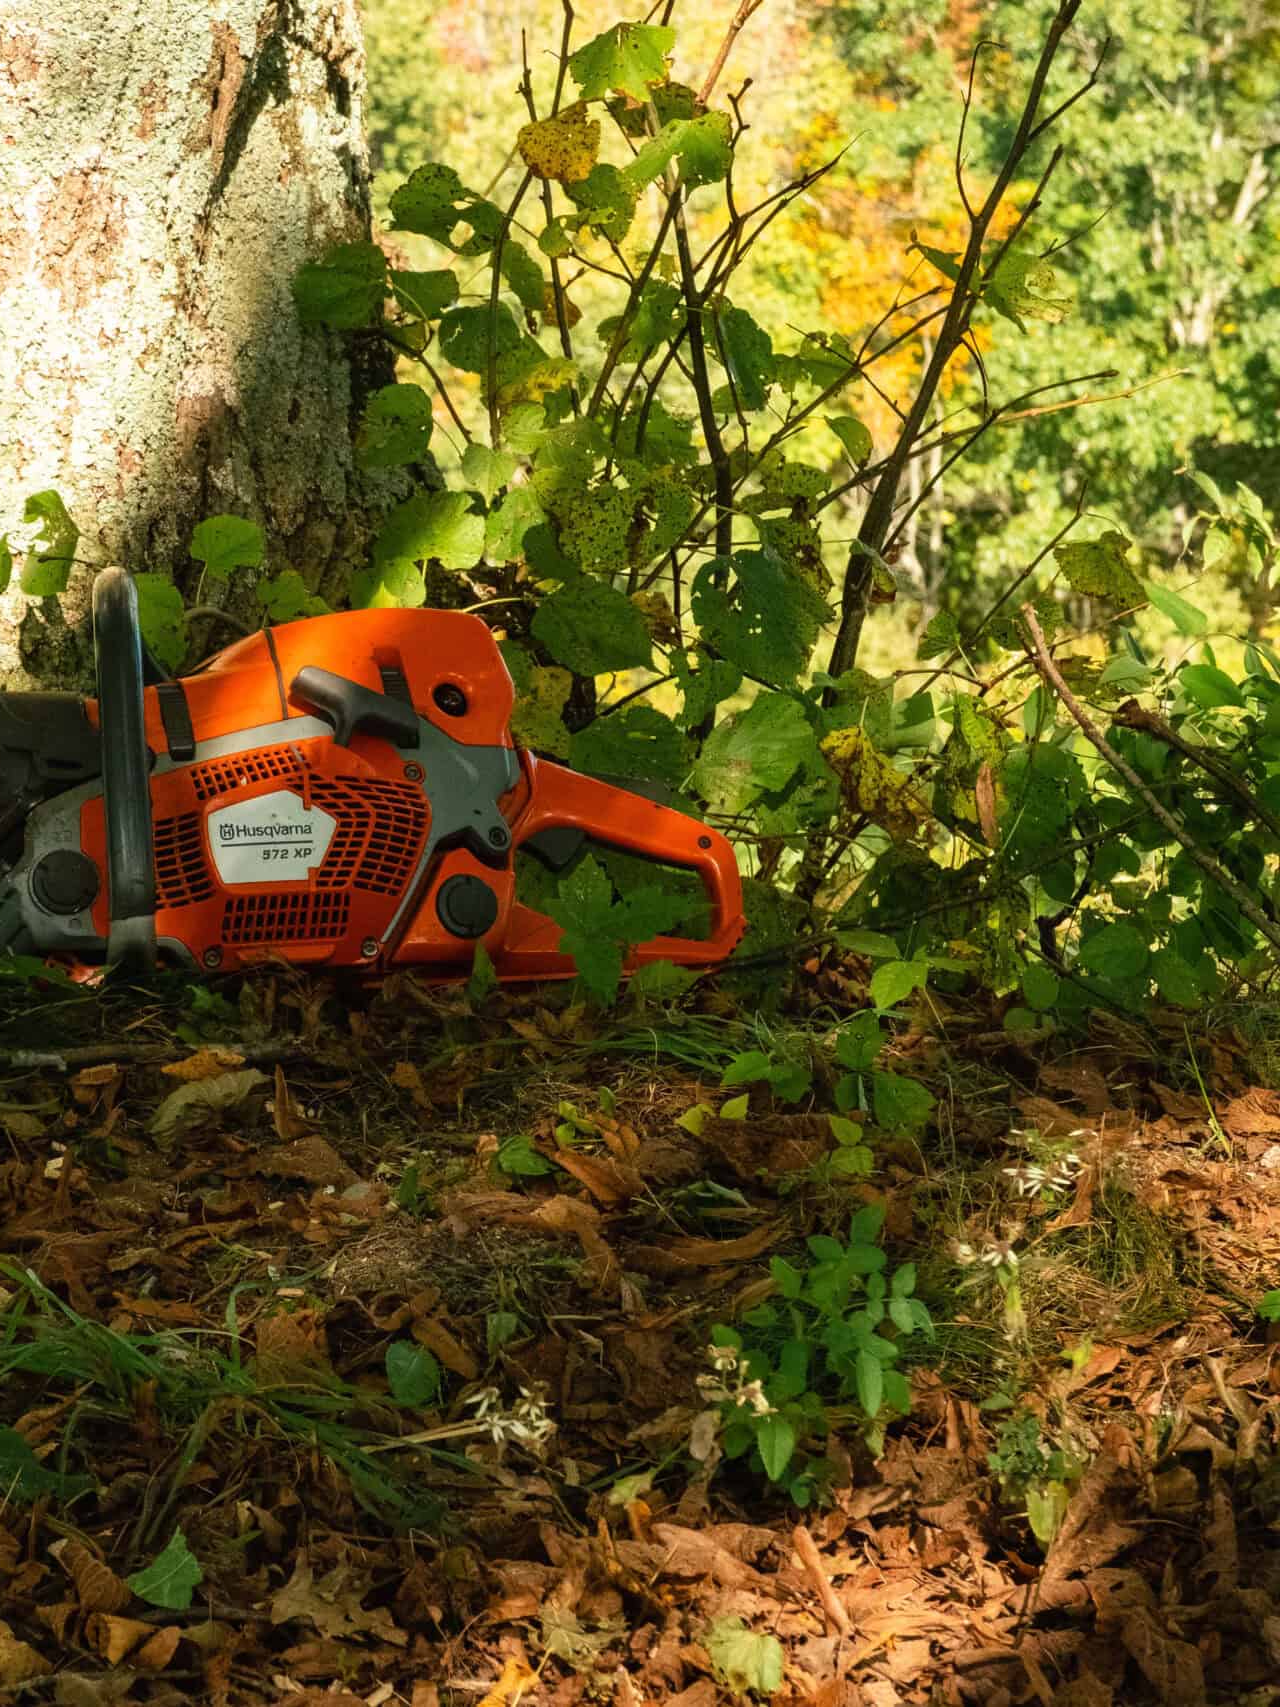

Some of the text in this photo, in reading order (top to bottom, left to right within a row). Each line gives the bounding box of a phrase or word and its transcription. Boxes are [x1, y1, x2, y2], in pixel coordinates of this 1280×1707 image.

[236, 823, 312, 838] Husqvarna
[263, 848, 312, 860] 572 XP
